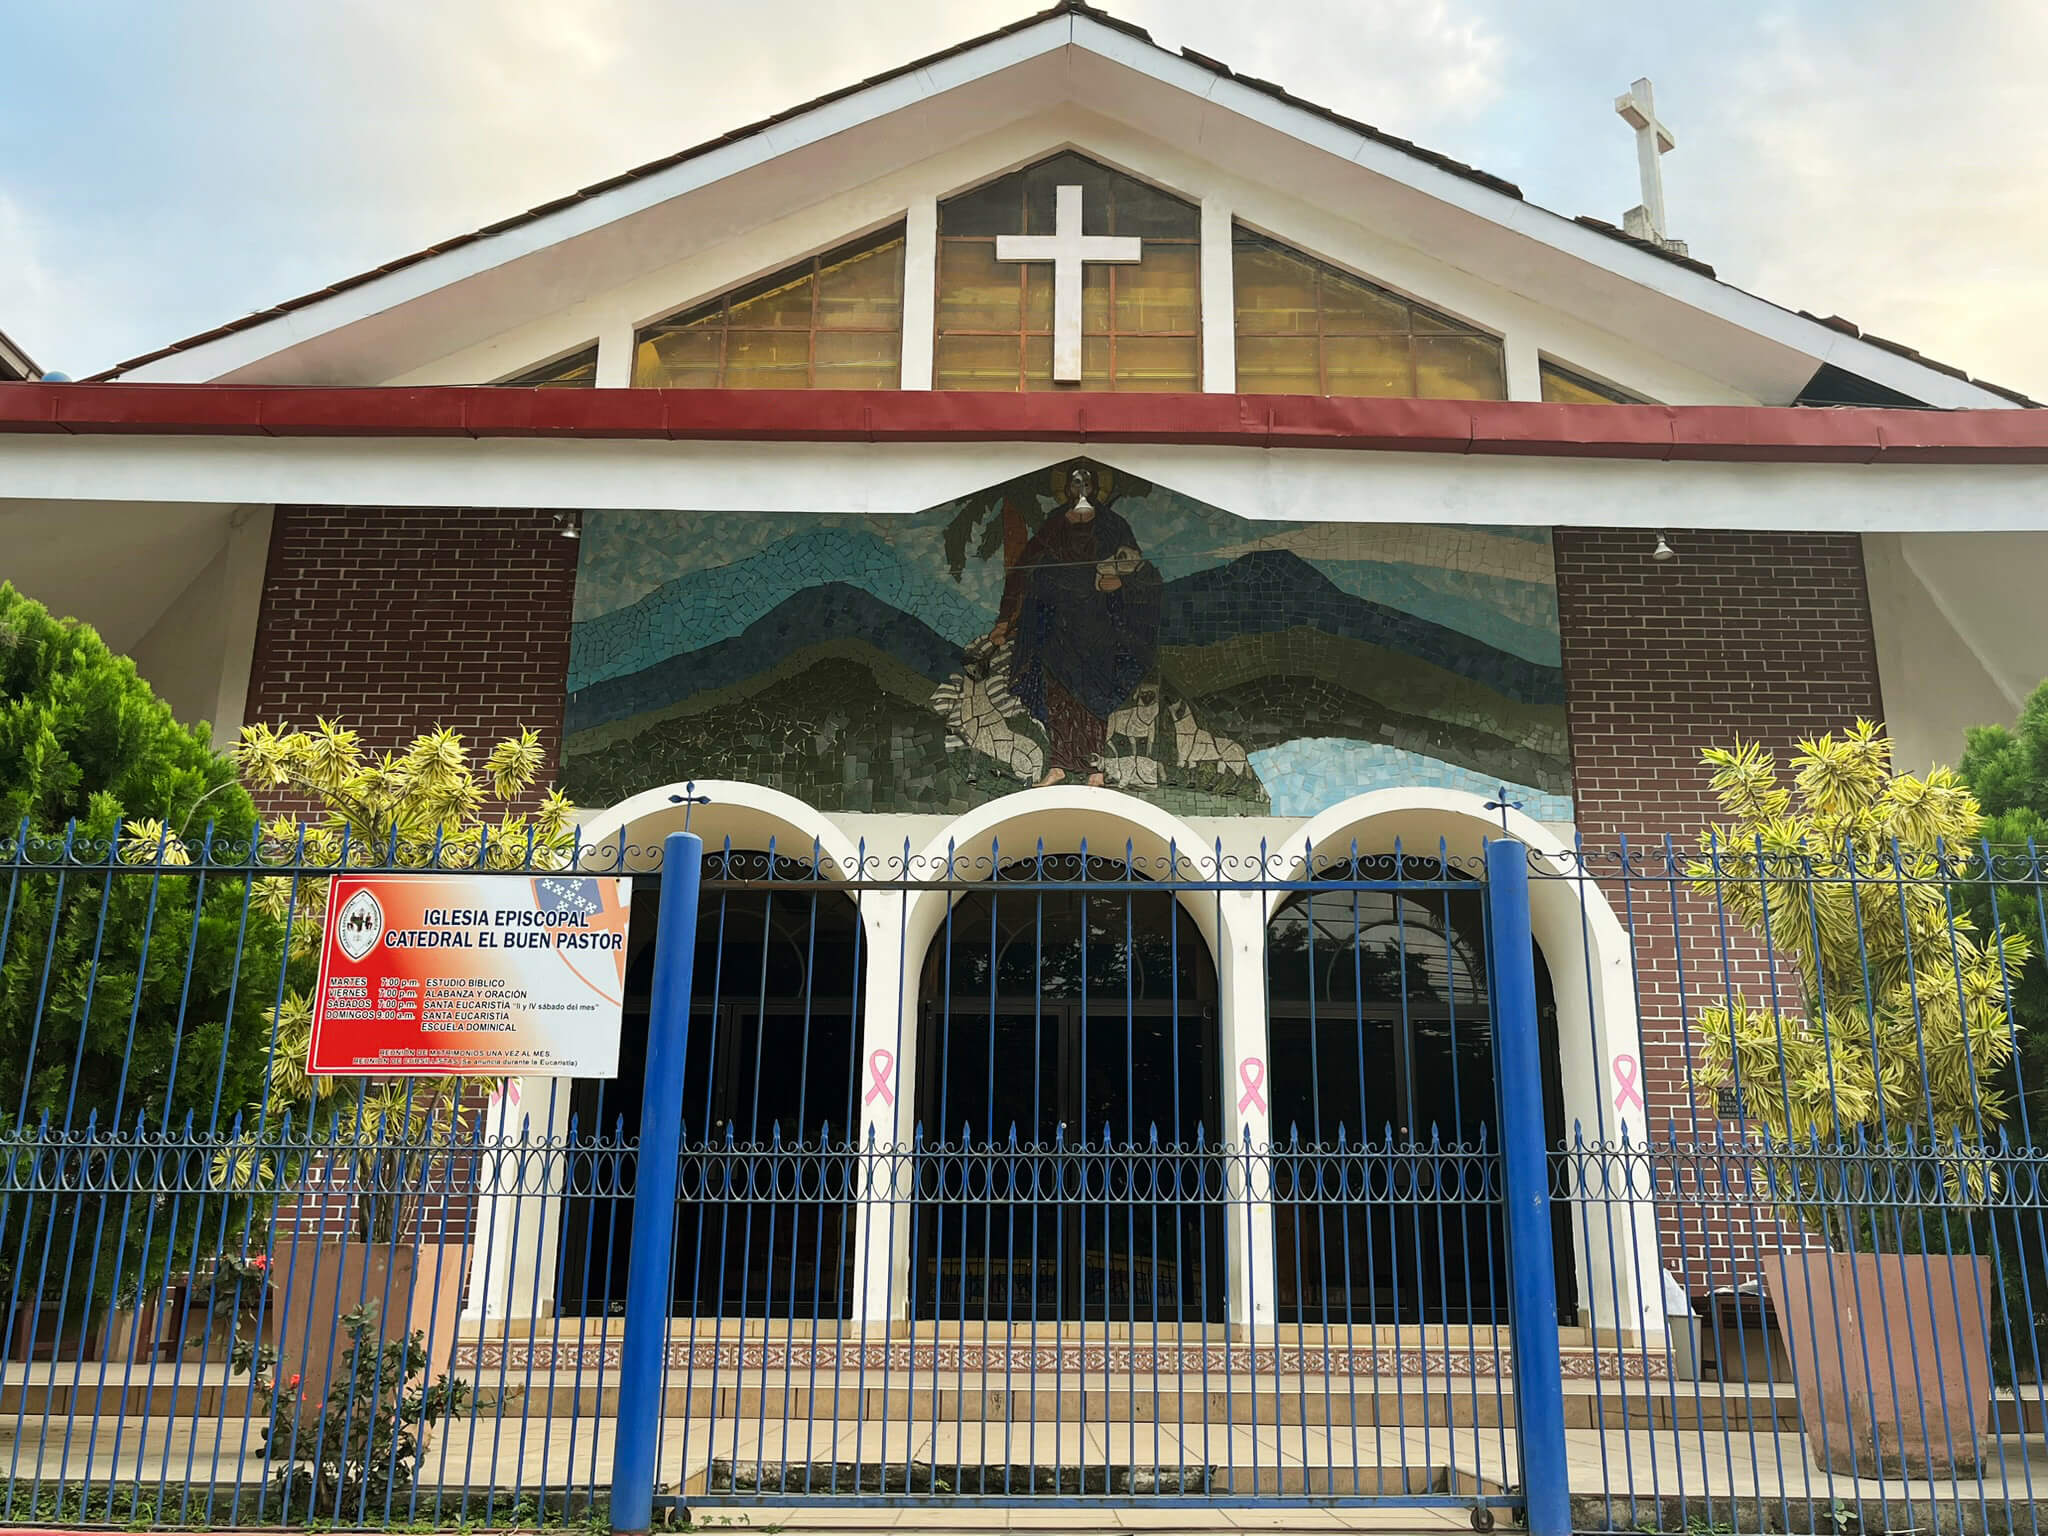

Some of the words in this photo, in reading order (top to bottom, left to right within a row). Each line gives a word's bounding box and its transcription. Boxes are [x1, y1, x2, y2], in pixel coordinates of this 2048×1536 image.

[423, 908, 490, 927] IGLESIA
[495, 910, 590, 928] EPISCOPAL
[385, 930, 473, 948] CATEDRAL
[478, 931, 499, 949] EL
[503, 931, 551, 949] BUEN
[556, 932, 624, 951] PASTOR
[330, 977, 367, 987] MARTES
[381, 977, 400, 987] 7:00
[426, 978, 466, 988] ESTUDIO
[328, 988, 367, 998] VIERNES
[379, 988, 398, 998] 7:00
[425, 989, 475, 999] ALABANZA
[476, 990, 483, 999] Y
[484, 989, 528, 1000] ORACIÓN
[378, 1000, 396, 1010] 7:00
[424, 1000, 454, 1010] SANTA
[522, 1004, 528, 1012] y
[566, 1003, 579, 1011] del
[326, 1010, 375, 1020] DOMINGOS
[376, 1010, 396, 1020] 9:00
[423, 1011, 453, 1021] SANTA
[421, 1022, 465, 1032] ESCUELA
[466, 1022, 518, 1033] DOMINICAL
[486, 1050, 503, 1058] UNA
[505, 1050, 520, 1058] VEZ
